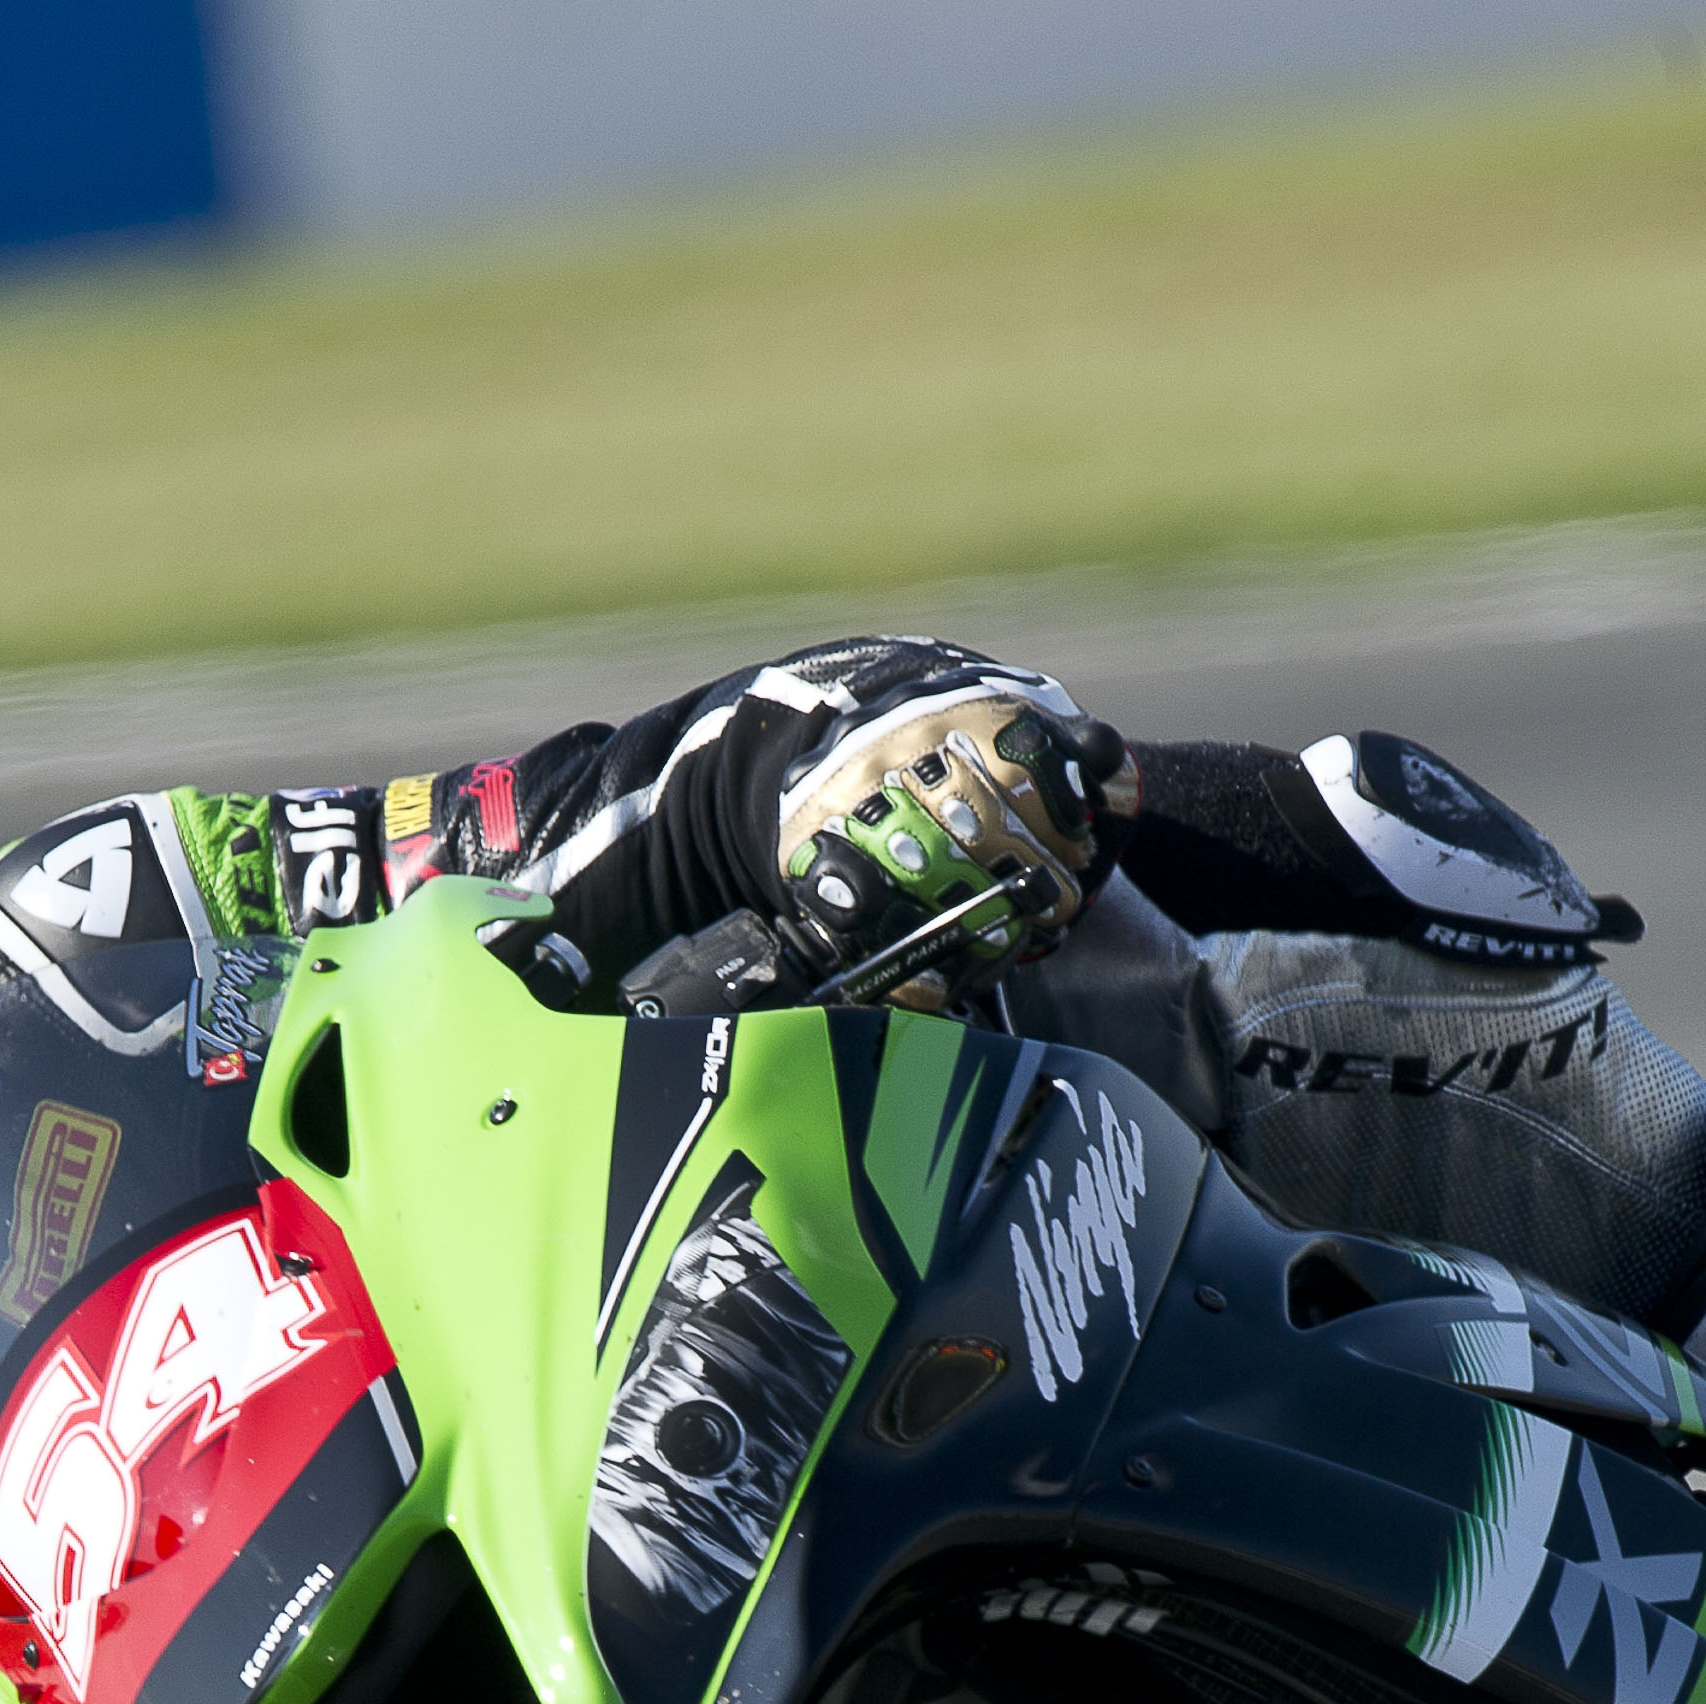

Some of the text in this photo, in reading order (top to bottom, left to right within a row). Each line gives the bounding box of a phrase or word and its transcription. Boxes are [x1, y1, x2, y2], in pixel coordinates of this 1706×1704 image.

[185, 948, 271, 1081] Toprak
[1010, 1078, 1145, 1403] Ninja
[239, 1562, 335, 1689] Kawasaki
